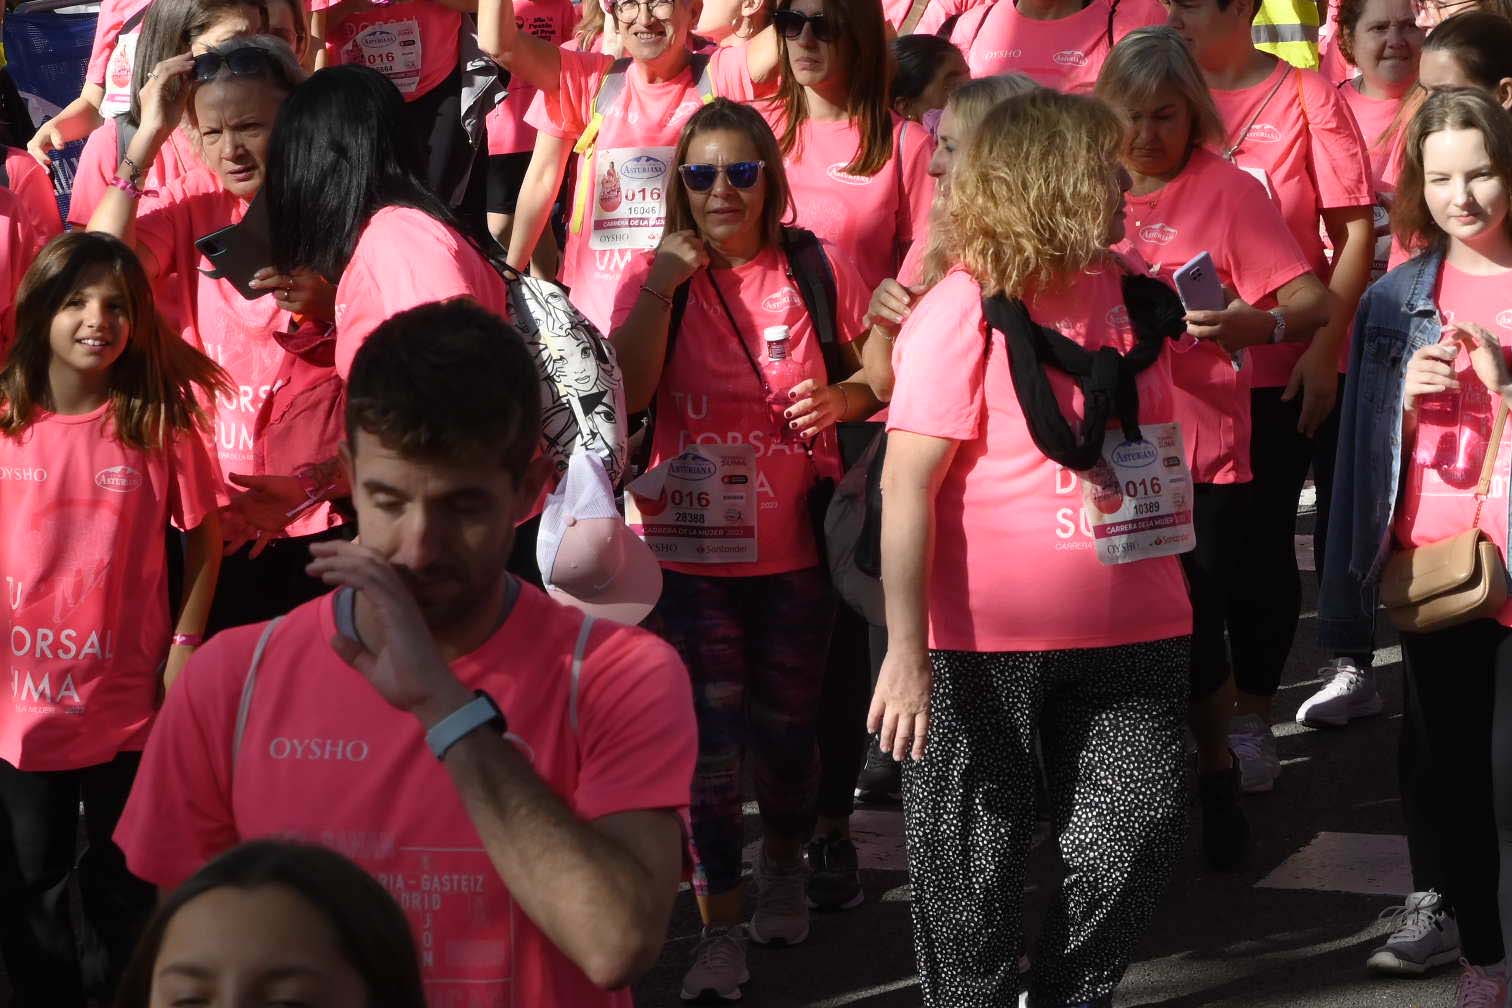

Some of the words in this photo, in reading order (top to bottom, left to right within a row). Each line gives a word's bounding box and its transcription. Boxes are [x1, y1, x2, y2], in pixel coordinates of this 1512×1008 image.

[367, 52, 395, 65] 016
[624, 187, 661, 202] 016
[668, 464, 714, 475] ASTURIANA
[1125, 477, 1162, 498] 016
[670, 489, 711, 508] 016
[1133, 502, 1160, 515] 10389
[674, 512, 706, 524] 28388
[269, 737, 369, 761] OYSHO
[421, 874, 484, 892] GASTEIZ
